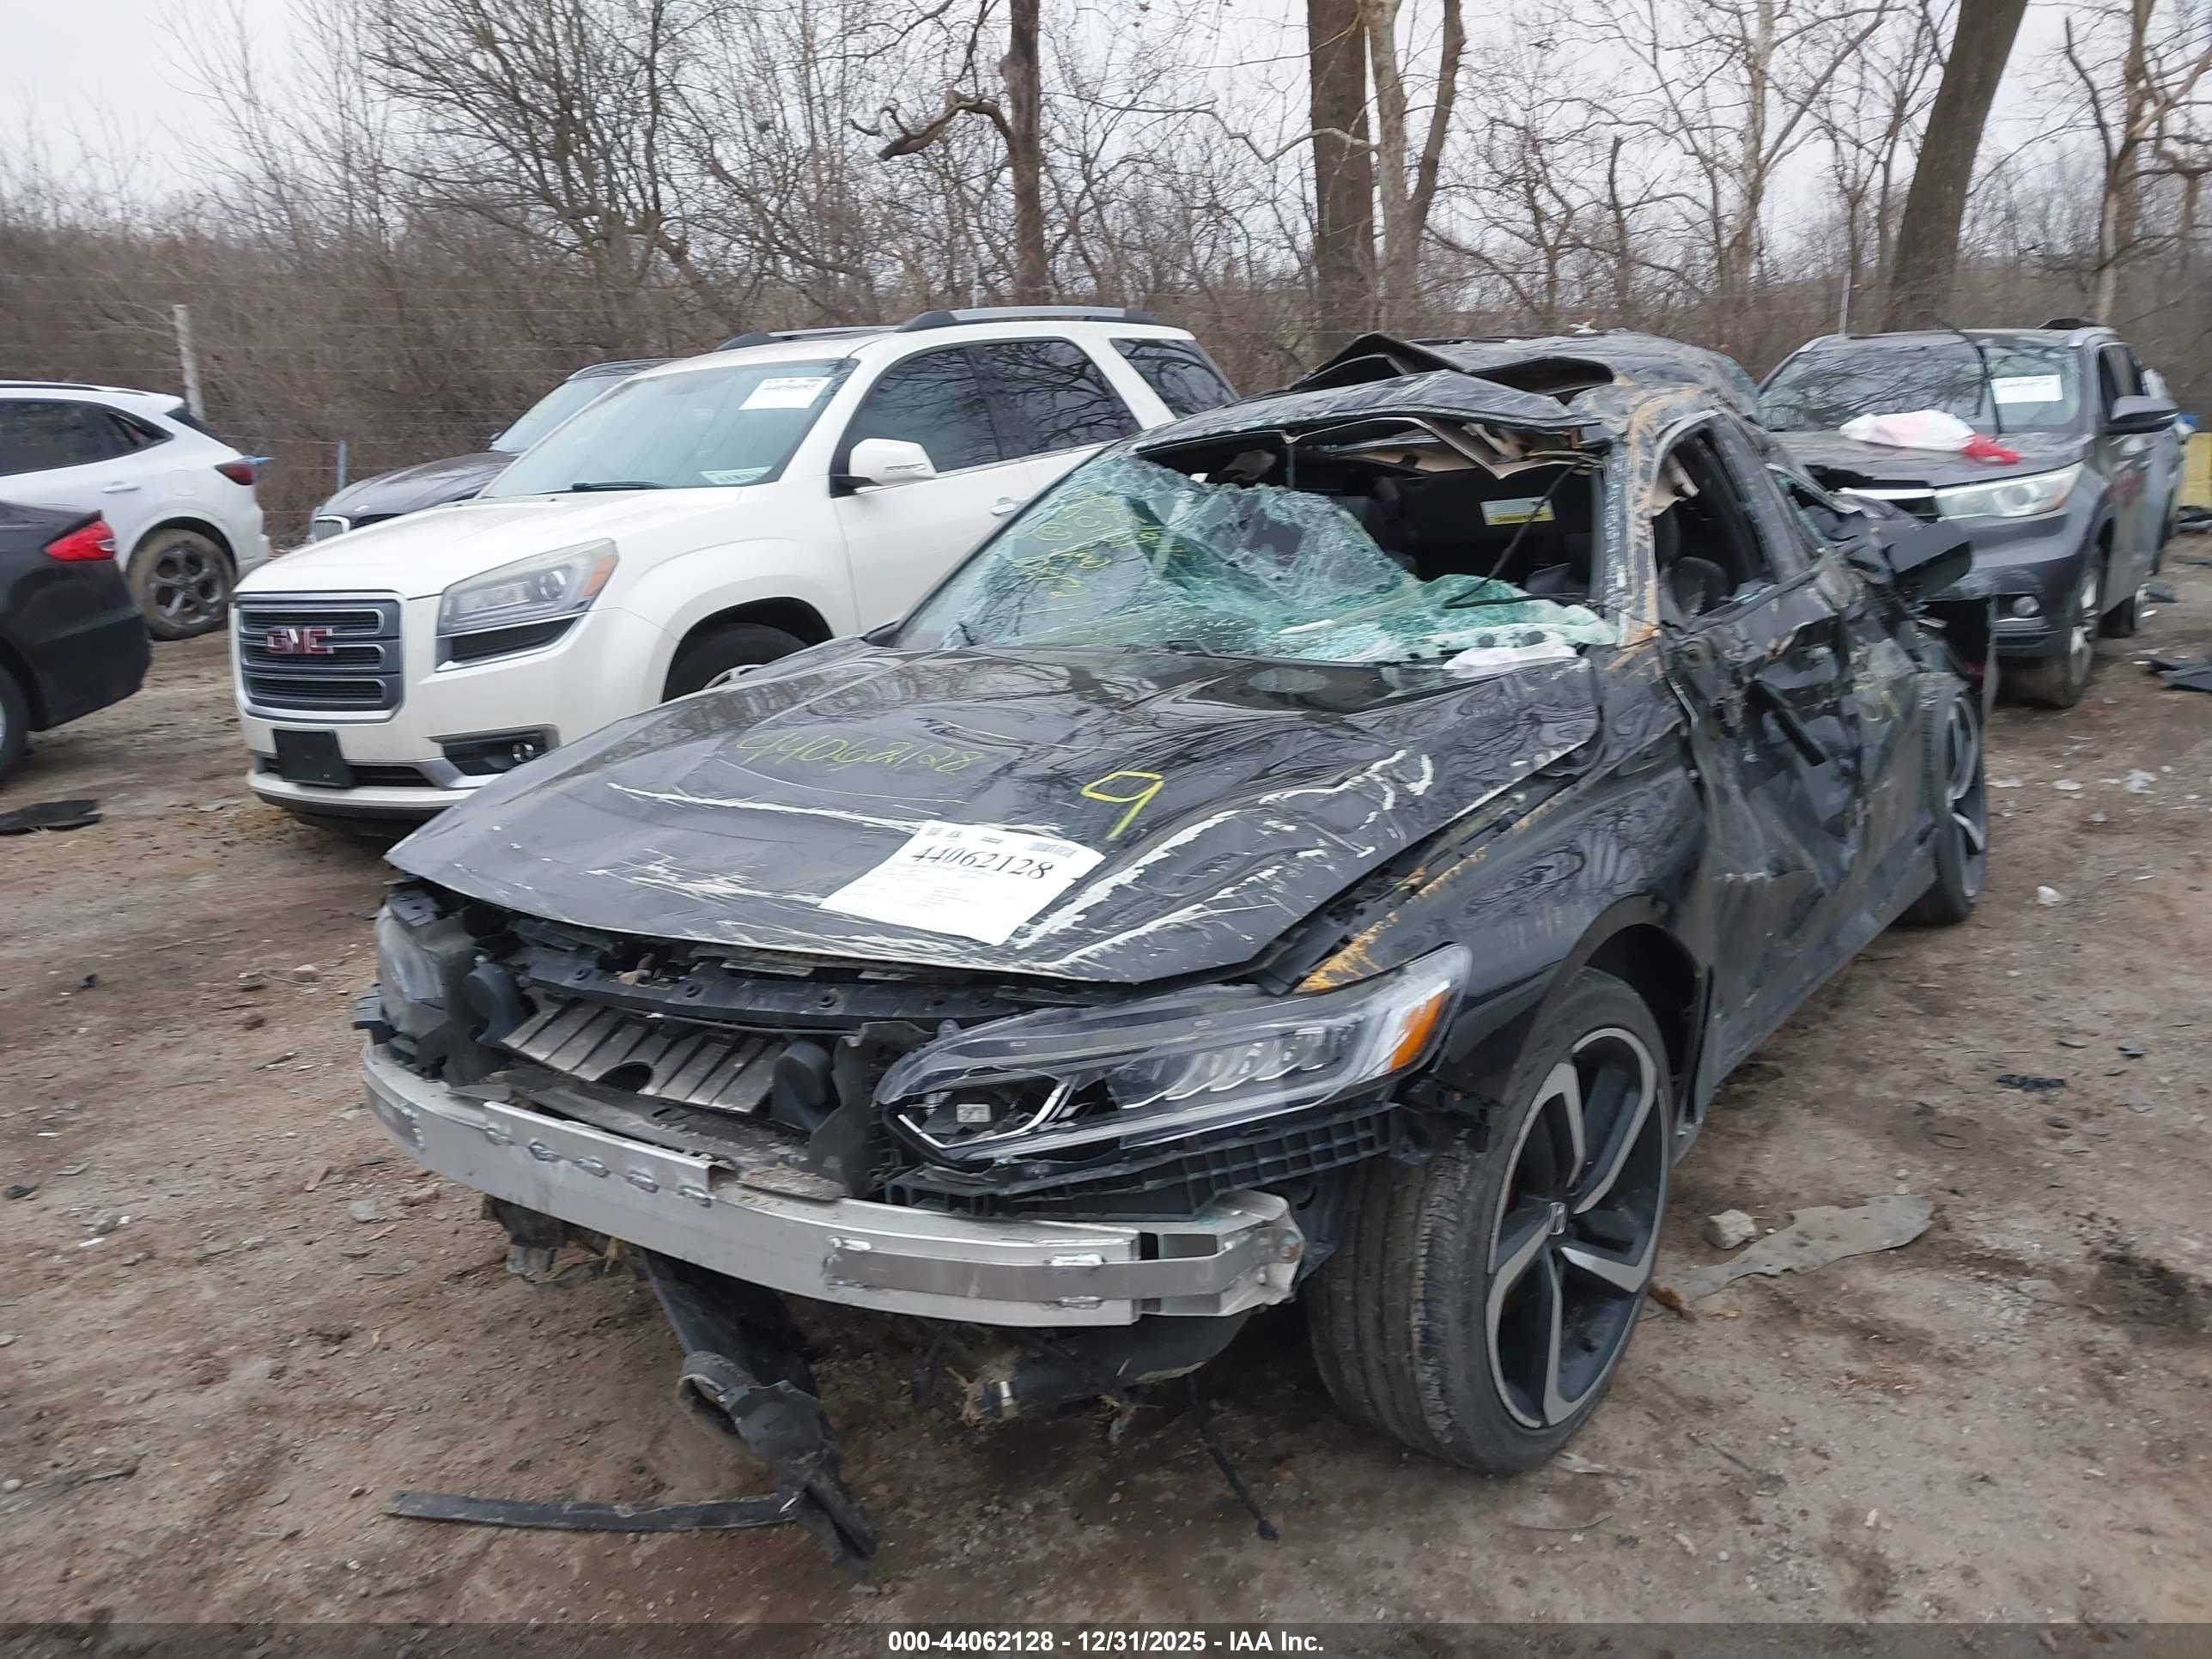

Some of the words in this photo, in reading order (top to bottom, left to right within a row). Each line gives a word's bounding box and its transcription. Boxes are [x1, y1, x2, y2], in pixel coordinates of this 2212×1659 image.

[265, 628, 334, 653] GMC
[736, 734, 988, 775] 44062128
[1081, 770, 1164, 841] 9
[911, 846, 1054, 880] 44062128
